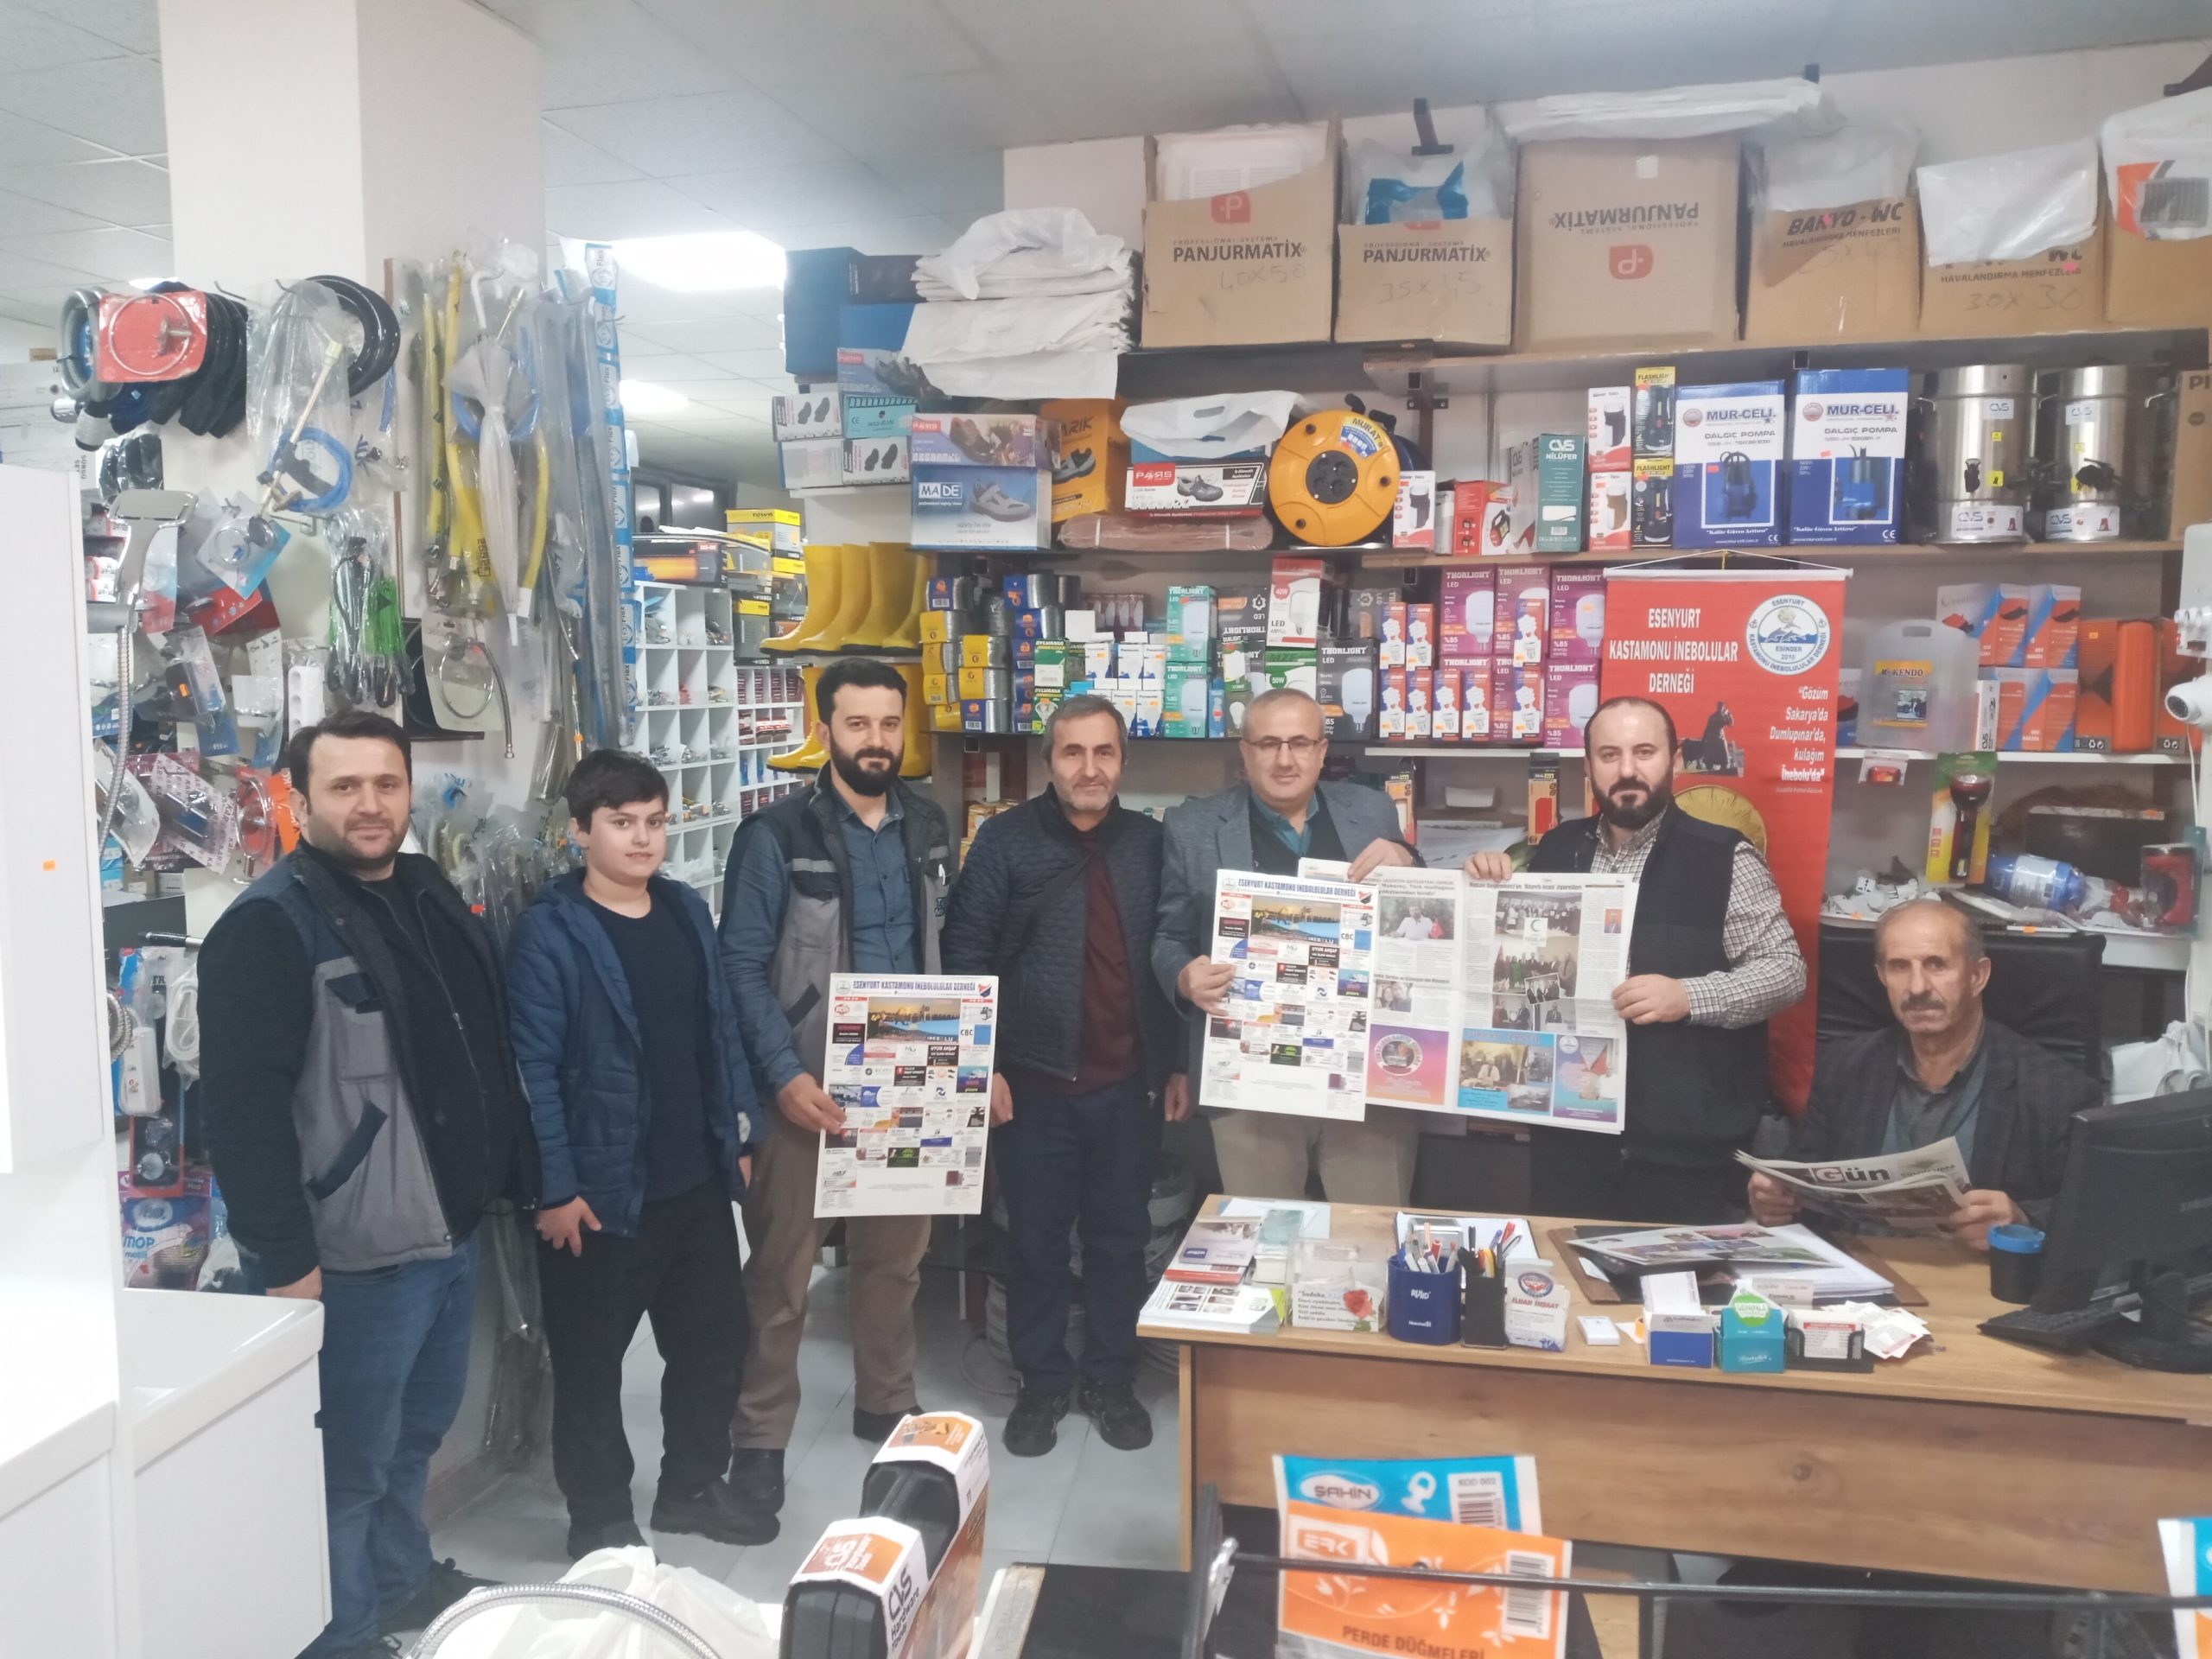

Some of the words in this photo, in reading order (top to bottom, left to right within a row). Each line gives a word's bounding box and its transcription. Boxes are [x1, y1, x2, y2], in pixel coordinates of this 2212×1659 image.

[1554, 202, 1699, 231] PANJURMATİX
[1871, 202, 1904, 222] WC
[1173, 238, 1302, 262] PANJURMATİX
[1363, 242, 1486, 263] PANJURMATİX
[1941, 270, 2018, 283] HAVALANDIRMA
[1352, 417, 1381, 440] MURAT
[1548, 439, 1575, 451] CVS
[1135, 470, 1173, 480] PARS
[921, 485, 959, 496] MADE
[1499, 567, 1545, 575] THORLIGHT
[1648, 608, 1700, 628] ESENYURT
[1610, 640, 1671, 660] KASTAMONU
[1674, 636, 1738, 662] İNEBOLULAR
[1750, 633, 1770, 666] KASTAMONU
[1649, 668, 1694, 693] DERNEĞİ
[1786, 707, 1828, 724] Sakarya'da
[1770, 726, 1826, 744] Dumlupınar'da,
[1794, 747, 1824, 765] kulağım
[1781, 764, 1825, 781] İnebolu'da"
[1238, 879, 1263, 887] ESENYURT
[1264, 881, 1296, 891] KASTAMONU
[1334, 887, 1356, 897] DERNEĞİ
[853, 981, 880, 989] ESENYURT
[880, 981, 914, 989] KASTAMONU
[953, 982, 976, 991] DERNEĞİ
[1815, 1166, 1891, 1182] Gün
[1314, 1484, 1371, 1500] ŞAHİN
[891, 1586, 919, 1641] Hardware
[1343, 1625, 1389, 1649] PERDE
[1394, 1631, 1485, 1659] DÜĞMELERİ
